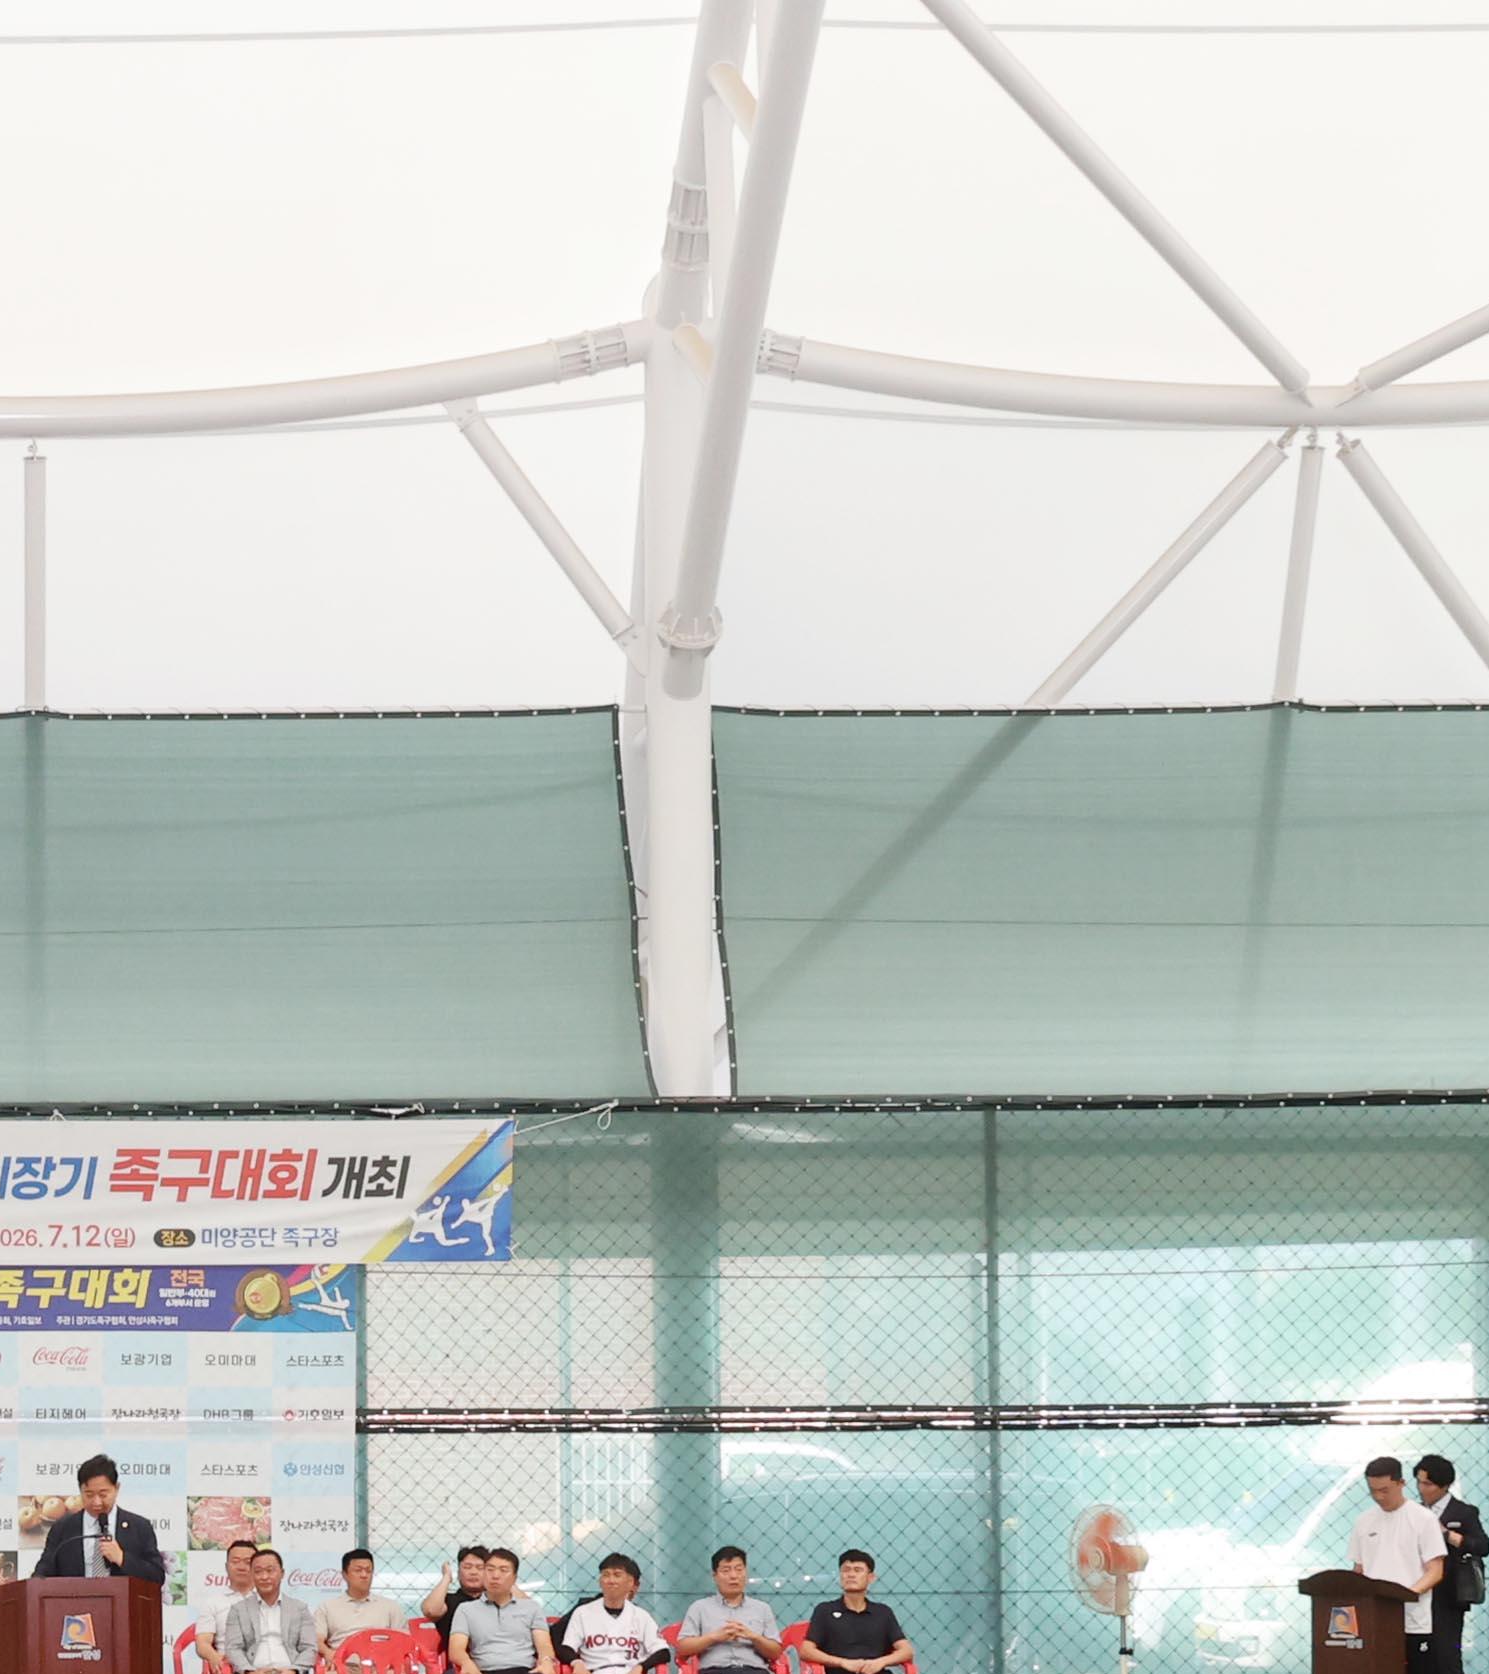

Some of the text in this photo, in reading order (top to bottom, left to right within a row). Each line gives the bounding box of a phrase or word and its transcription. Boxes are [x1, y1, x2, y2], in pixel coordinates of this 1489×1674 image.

[109, 1147, 318, 1202] 족구대회
[321, 1155, 412, 1201] 개최
[159, 1226, 340, 1249] 장소 미양공단 족구장
[170, 1269, 206, 1288] 전국
[121, 1353, 172, 1366] 보광기업
[205, 1353, 256, 1367] 오미마대
[286, 1354, 345, 1368] 스타스포츠
[120, 1463, 171, 1476] 오미마대
[201, 1463, 259, 1477] 스타스포츠
